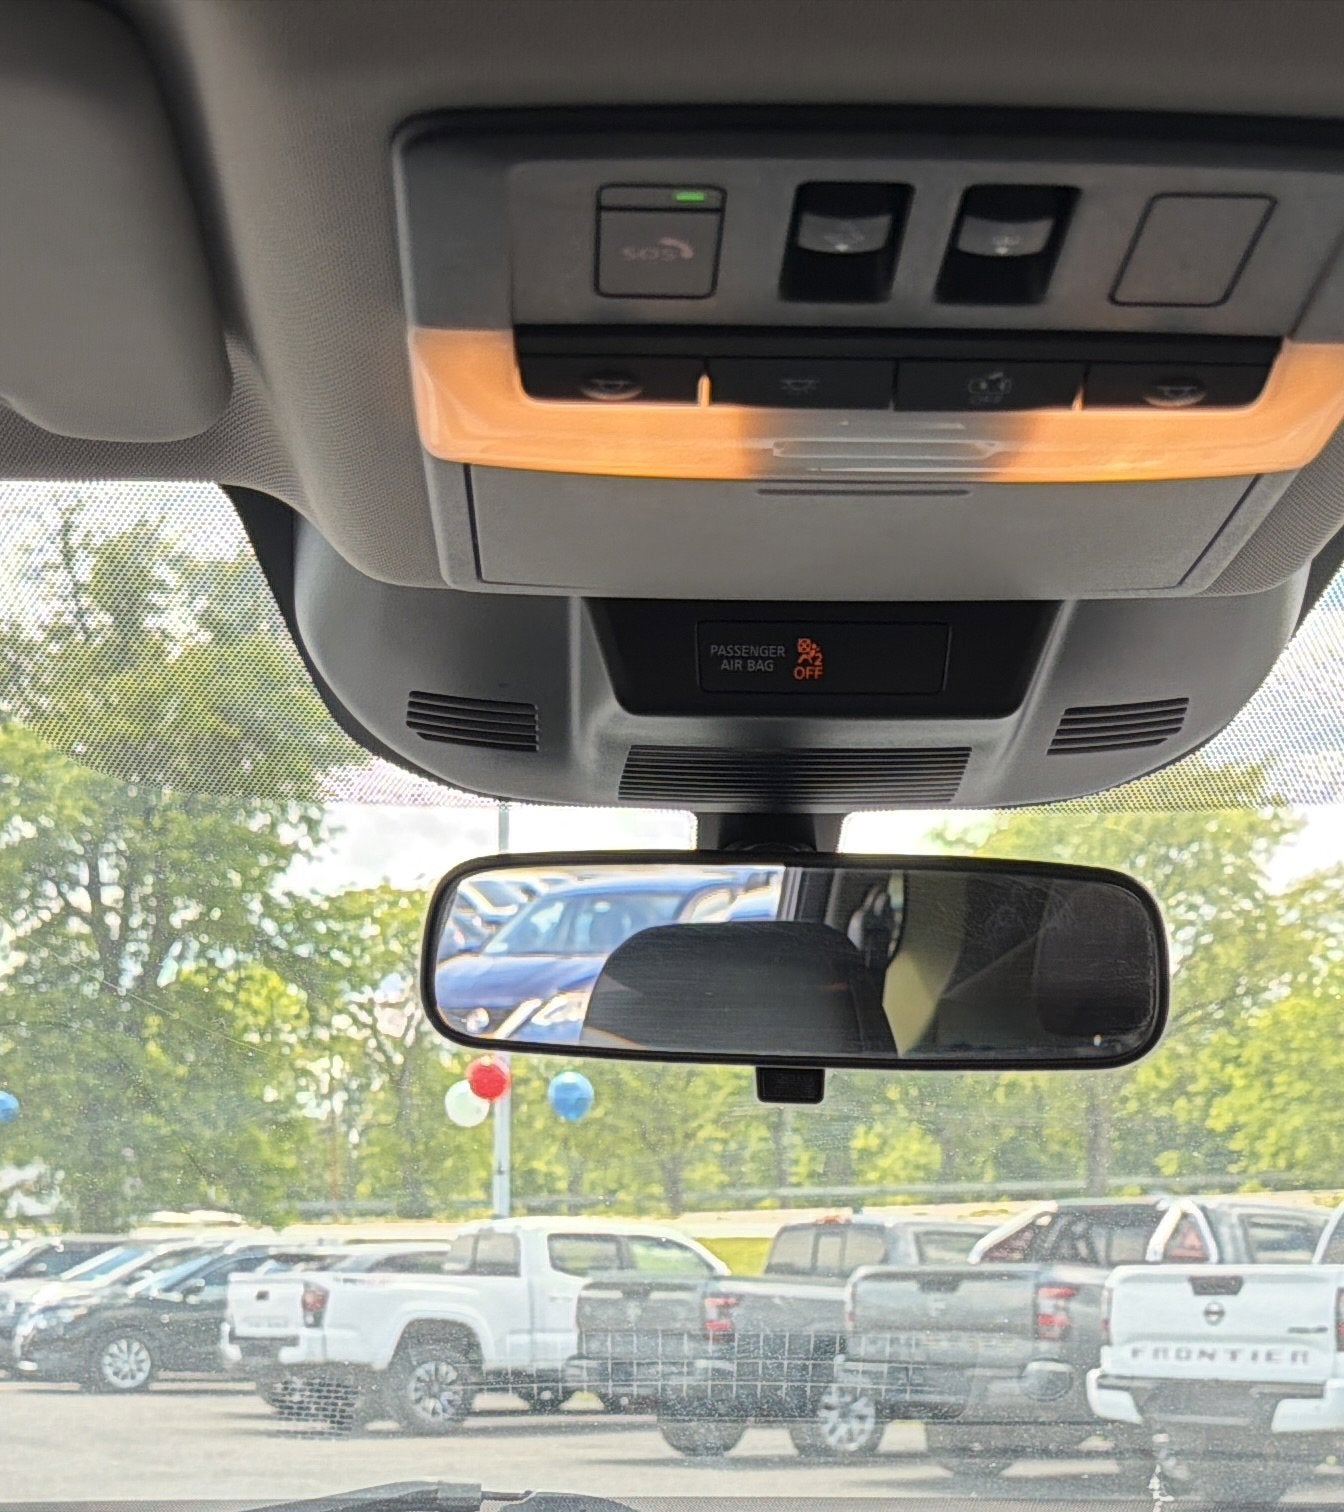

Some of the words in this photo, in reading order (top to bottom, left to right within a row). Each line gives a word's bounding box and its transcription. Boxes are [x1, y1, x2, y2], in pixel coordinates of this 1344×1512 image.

[710, 644, 786, 658] PASSENGER
[720, 659, 743, 672] AIR
[747, 659, 774, 672] BAG
[793, 666, 824, 680] OFF
[1130, 1346, 1309, 1364] FRONTIER
